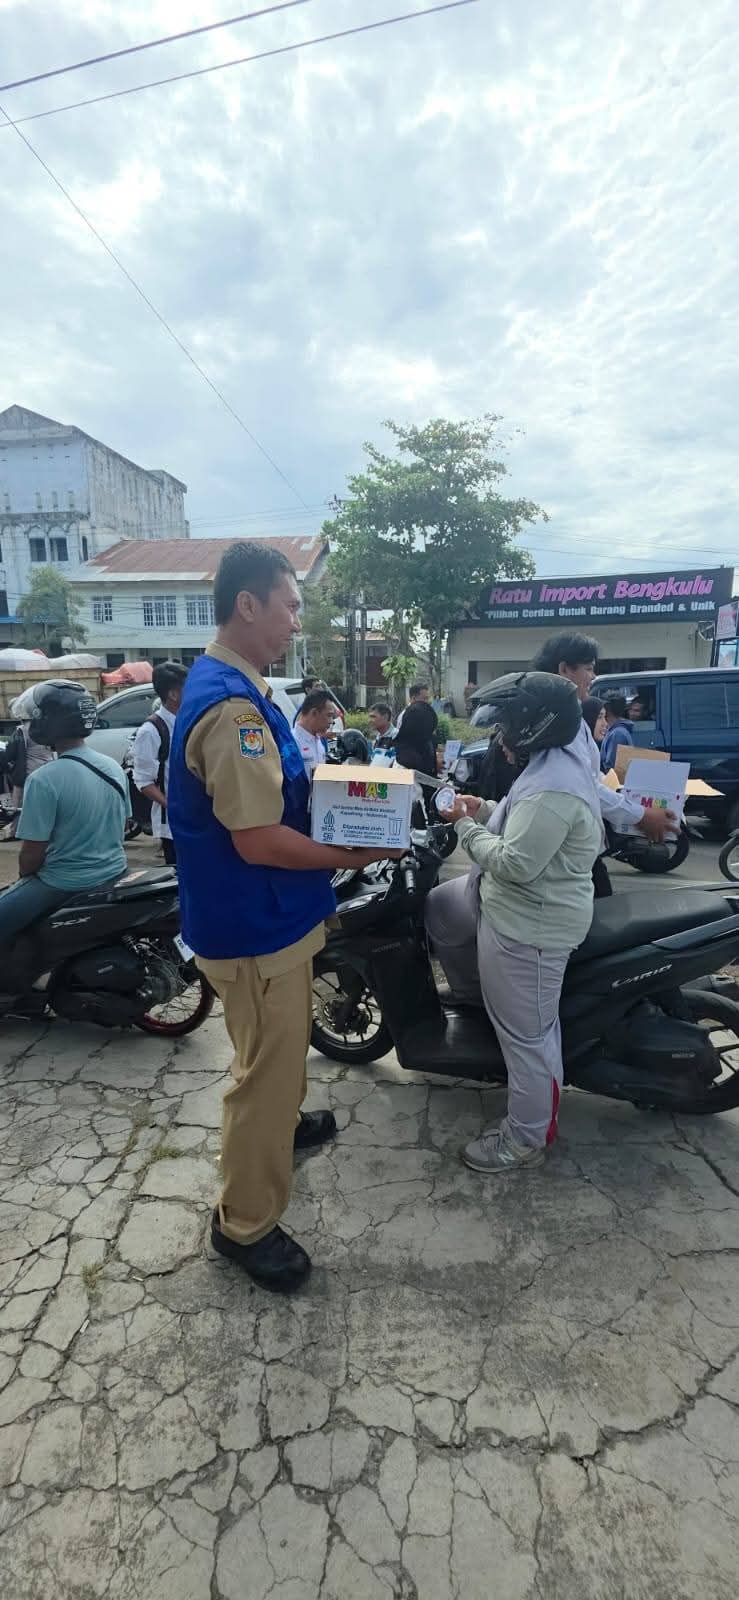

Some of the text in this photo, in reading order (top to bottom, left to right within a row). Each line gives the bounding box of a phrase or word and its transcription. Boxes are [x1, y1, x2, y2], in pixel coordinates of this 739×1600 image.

[489, 575, 714, 605] Ratu Import Bengkulu
[522, 608, 555, 618] Cerdas
[558, 606, 586, 616] Untuk
[590, 604, 626, 616] Barang
[630, 602, 674, 613] Branded
[678, 603, 686, 612] &
[690, 601, 716, 611] Unik
[348, 781, 388, 799] MAS
